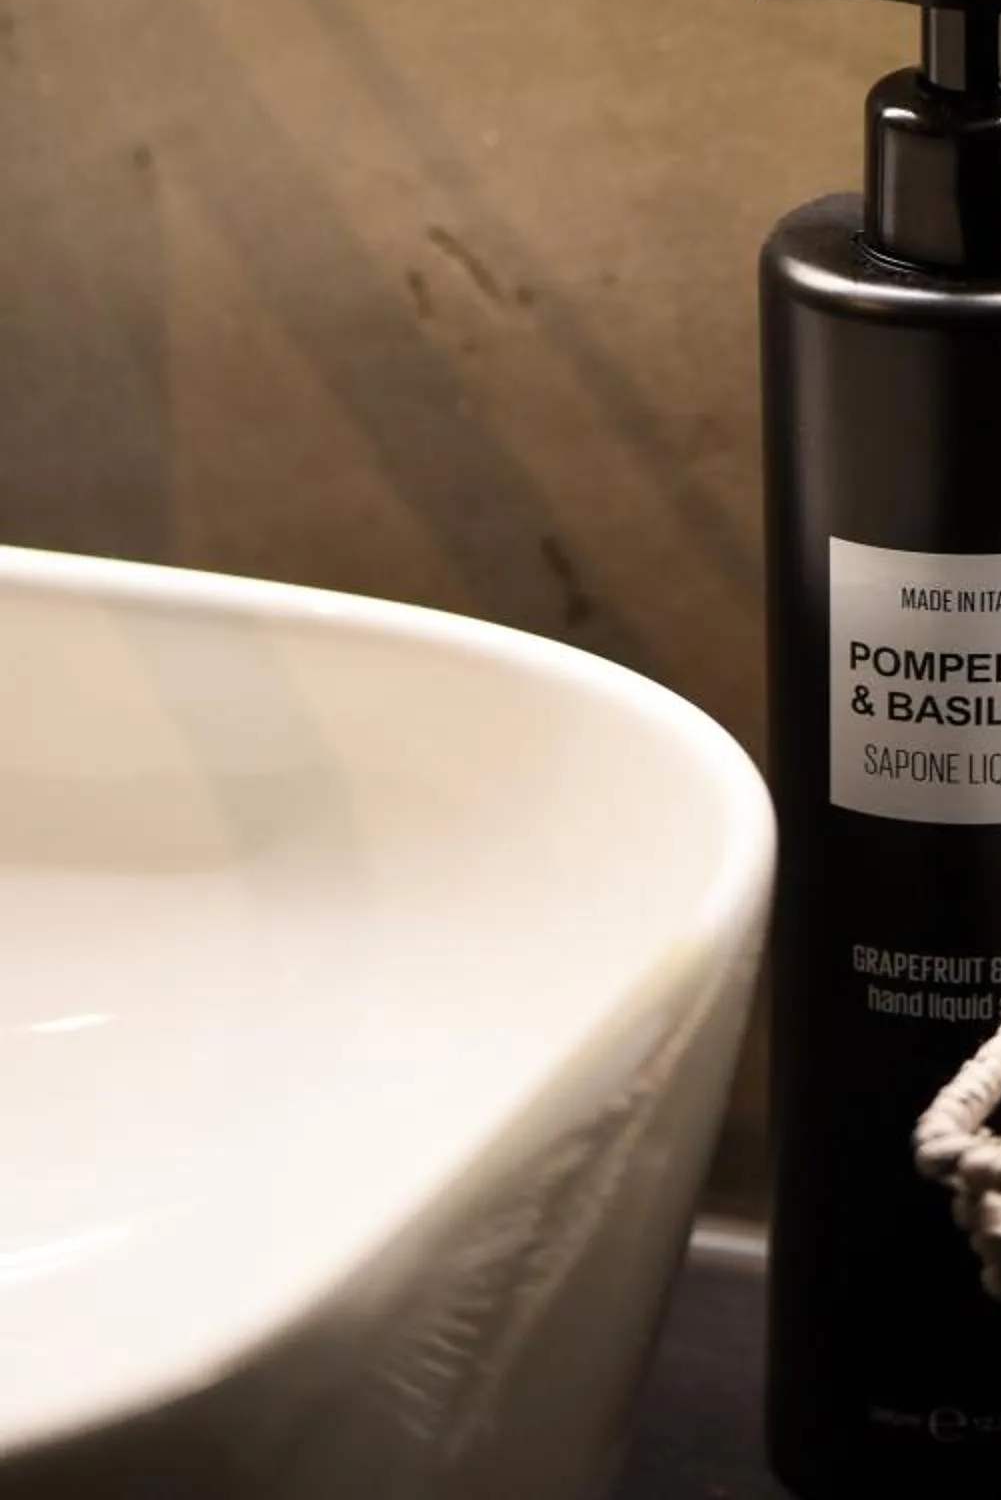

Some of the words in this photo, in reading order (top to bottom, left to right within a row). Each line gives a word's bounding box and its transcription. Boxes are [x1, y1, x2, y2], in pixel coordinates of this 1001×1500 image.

[901, 588, 952, 612] MADE
[957, 591, 975, 612] IN
[851, 685, 875, 716] &
[863, 744, 960, 784] SAPONE
[853, 945, 984, 984] GRAPEFRUIT
[867, 985, 922, 1018] hand
[929, 993, 993, 1022] liquid
